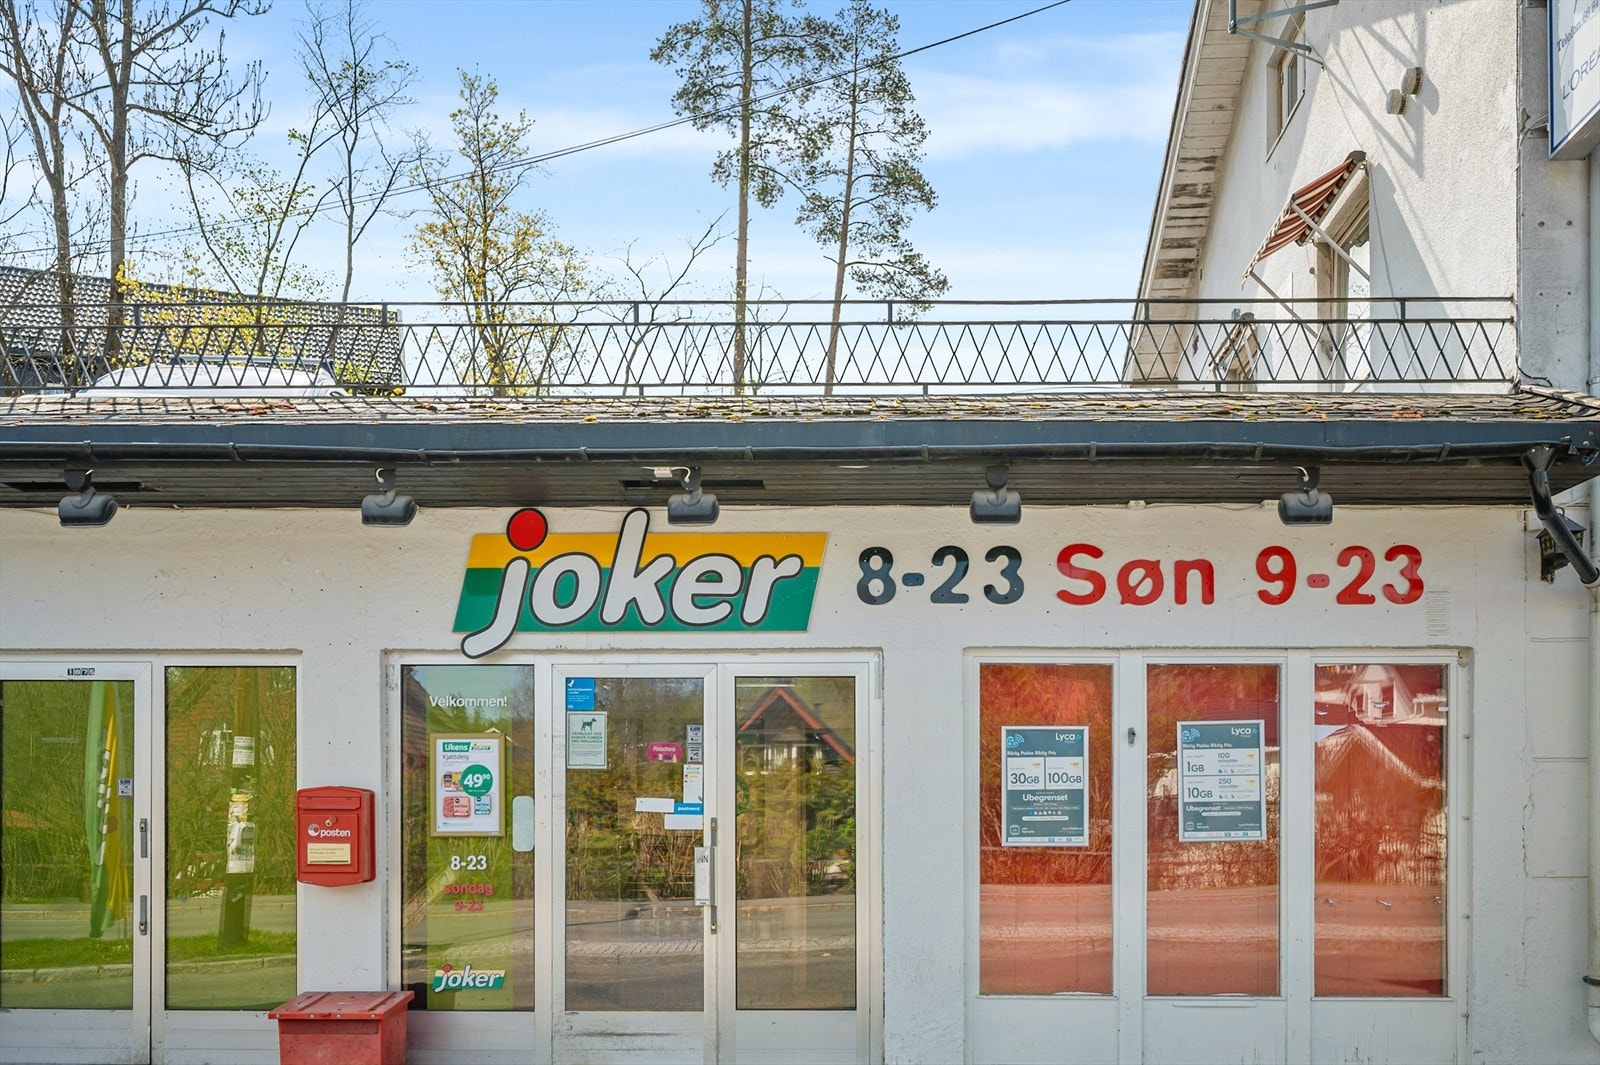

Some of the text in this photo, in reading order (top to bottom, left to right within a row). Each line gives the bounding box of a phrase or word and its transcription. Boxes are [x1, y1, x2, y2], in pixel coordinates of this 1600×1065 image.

[856, 543, 1425, 606] 8-23 Søn 9-23
[461, 508, 804, 659] joker
[429, 696, 508, 707] Velkommen!
[1231, 727, 1251, 735] Lyca
[1056, 732, 1075, 742] Lyca
[1187, 762, 1204, 772] 1GB
[1010, 773, 1040, 784] 30GB
[1048, 772, 1082, 783] 100GB
[1022, 794, 1068, 802] Ubegrenset
[1187, 787, 1213, 798] 10GB
[320, 828, 350, 838] posten
[450, 855, 487, 870] 8-23
[444, 882, 493, 896] søndag
[454, 900, 483, 912] 9-23
[435, 964, 500, 992] joker
